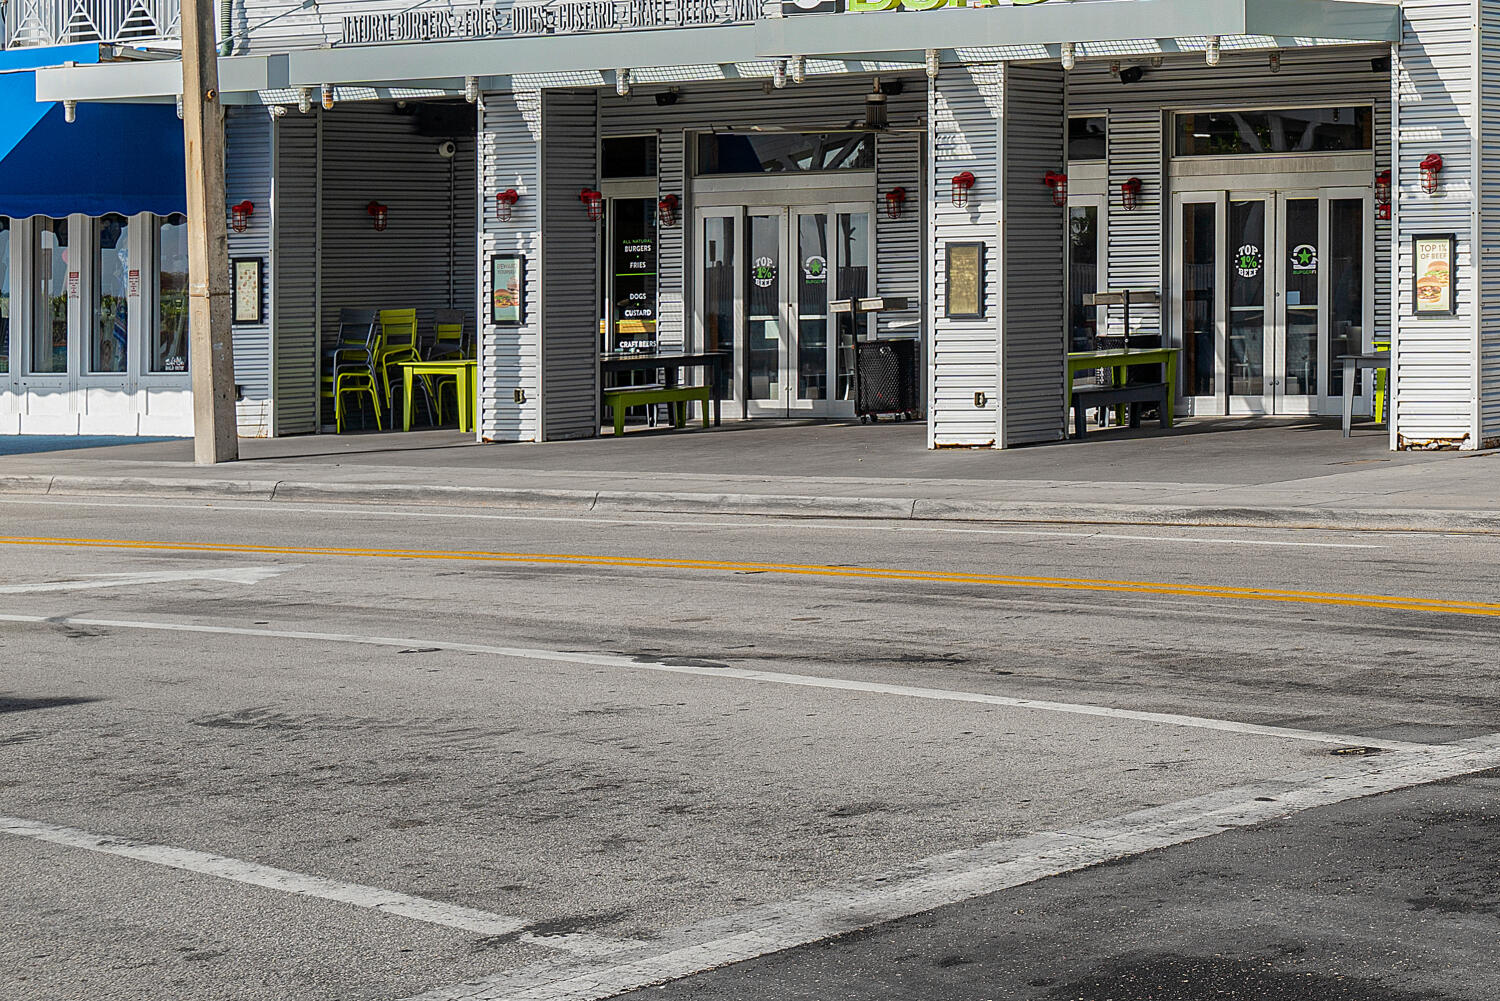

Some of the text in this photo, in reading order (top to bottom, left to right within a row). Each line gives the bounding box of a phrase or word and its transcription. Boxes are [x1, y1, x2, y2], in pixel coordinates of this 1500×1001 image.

[341, 13, 394, 43] NATURAL
[398, 10, 451, 40] BURGERS
[465, 8, 499, 36] FRIES
[512, 5, 546, 34] DOGS
[558, 1, 616, 31] CUSTARD
[624, 244, 652, 252] BURGERS
[1238, 244, 1259, 256] TOP
[1420, 244, 1437, 252] TOP
[629, 261, 647, 269] FRIES
[755, 256, 773, 267] TOP
[1240, 255, 1257, 268] 1%
[756, 266, 772, 279] 1%
[1238, 267, 1259, 278] BEEF
[755, 278, 773, 288] BEEF
[629, 292, 647, 300] DOGS
[624, 309, 652, 317] CUSTARD
[619, 340, 657, 348] CRAFT BEERS
